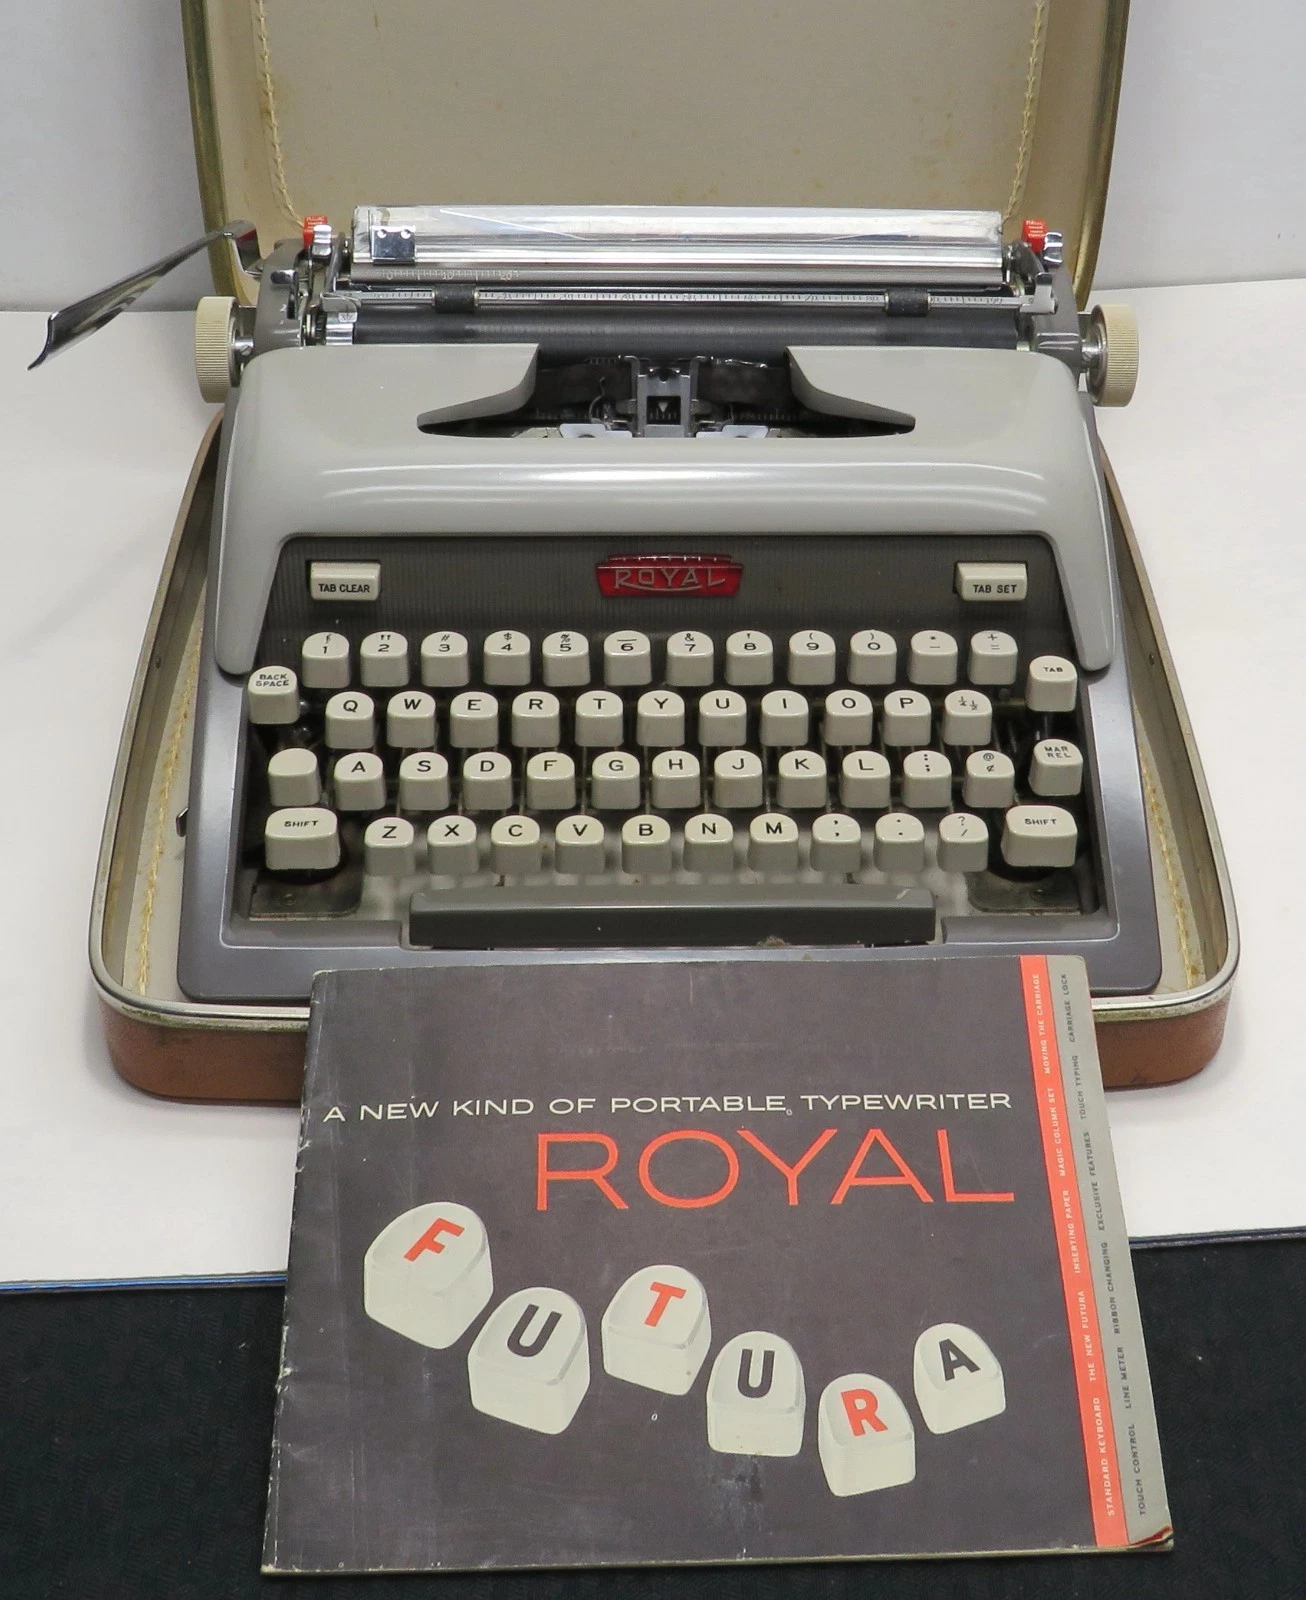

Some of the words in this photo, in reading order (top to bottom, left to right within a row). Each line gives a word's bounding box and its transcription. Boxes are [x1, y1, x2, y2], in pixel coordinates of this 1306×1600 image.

[614, 568, 726, 591] ROYAL
[319, 584, 336, 592] TAB
[338, 584, 370, 593] CLEAR
[973, 585, 991, 594] TAB
[996, 585, 1017, 594] SET
[503, 632, 512, 641] $
[560, 634, 571, 643] %
[684, 633, 695, 641] &
[987, 633, 998, 641] +
[322, 646, 328, 654] 1
[377, 644, 390, 653] 2
[438, 644, 451, 652] 3
[500, 643, 513, 652] 4
[559, 643, 572, 652] 5
[620, 643, 634, 652] 6
[684, 643, 696, 652] 7
[743, 642, 757, 651] 8
[806, 642, 819, 651] 9
[343, 700, 359, 713] Q
[403, 699, 422, 710] W
[467, 699, 482, 711] E
[528, 698, 544, 710] R
[592, 698, 606, 710] T
[653, 698, 669, 710] Y
[715, 698, 730, 710] U
[782, 698, 787, 709] I
[841, 698, 857, 709] O
[899, 698, 914, 709] P
[983, 752, 995, 761] @
[351, 761, 366, 773] A
[416, 760, 431, 772] S
[480, 760, 495, 772] D
[543, 760, 557, 772] F
[608, 760, 624, 772] G
[668, 758, 684, 770] H
[731, 758, 745, 770] J
[794, 758, 810, 770] K
[858, 759, 874, 771] L
[284, 820, 319, 828] SHIFT
[957, 815, 966, 826] ?
[1024, 818, 1057, 826] SHIFT
[381, 825, 397, 839] Z
[444, 825, 460, 837] X
[508, 824, 523, 837] C
[571, 824, 588, 836] V
[638, 824, 653, 836] B
[701, 823, 717, 835] N
[765, 822, 783, 835] M
[1061, 974, 1069, 995] LOCK
[1033, 974, 1043, 1015] CARRIAGE
[1065, 1000, 1075, 1042] CARRIAGE
[1040, 1040, 1050, 1074] MOVING
[1072, 1055, 1081, 1086] TYPING
[1047, 1087, 1055, 1103] SET
[323, 1106, 346, 1122] A
[360, 1101, 439, 1120] NEW
[453, 1098, 534, 1116] KIND
[549, 1098, 596, 1115] OF
[611, 1095, 786, 1113] PORTABLE
[800, 1093, 1012, 1110] TYPEWRITER
[1077, 1091, 1086, 1119] TOUCH
[1050, 1107, 1062, 1144] COLUMN
[1083, 1132, 1096, 1176] FEATURES
[1056, 1149, 1065, 1176] MAGIC
[536, 1129, 1015, 1211] ROYAL
[1063, 1190, 1072, 1219] PAPER
[1091, 1182, 1104, 1231] EXCLUSIVE
[1068, 1223, 1080, 1273] INSERTING
[1101, 1242, 1114, 1292] CHANGING
[1078, 1291, 1088, 1328] FUTURA
[1109, 1297, 1120, 1334] RIBBON
[1084, 1335, 1093, 1356] NEW
[1117, 1347, 1127, 1380] METER
[1088, 1363, 1097, 1381] THE
[1122, 1385, 1131, 1409] LINE
[1093, 1398, 1107, 1453] KEYBOARD
[1128, 1424, 1140, 1473] CONTROL
[1102, 1459, 1115, 1516] STANDARD
[1135, 1479, 1146, 1515] TOUCH
